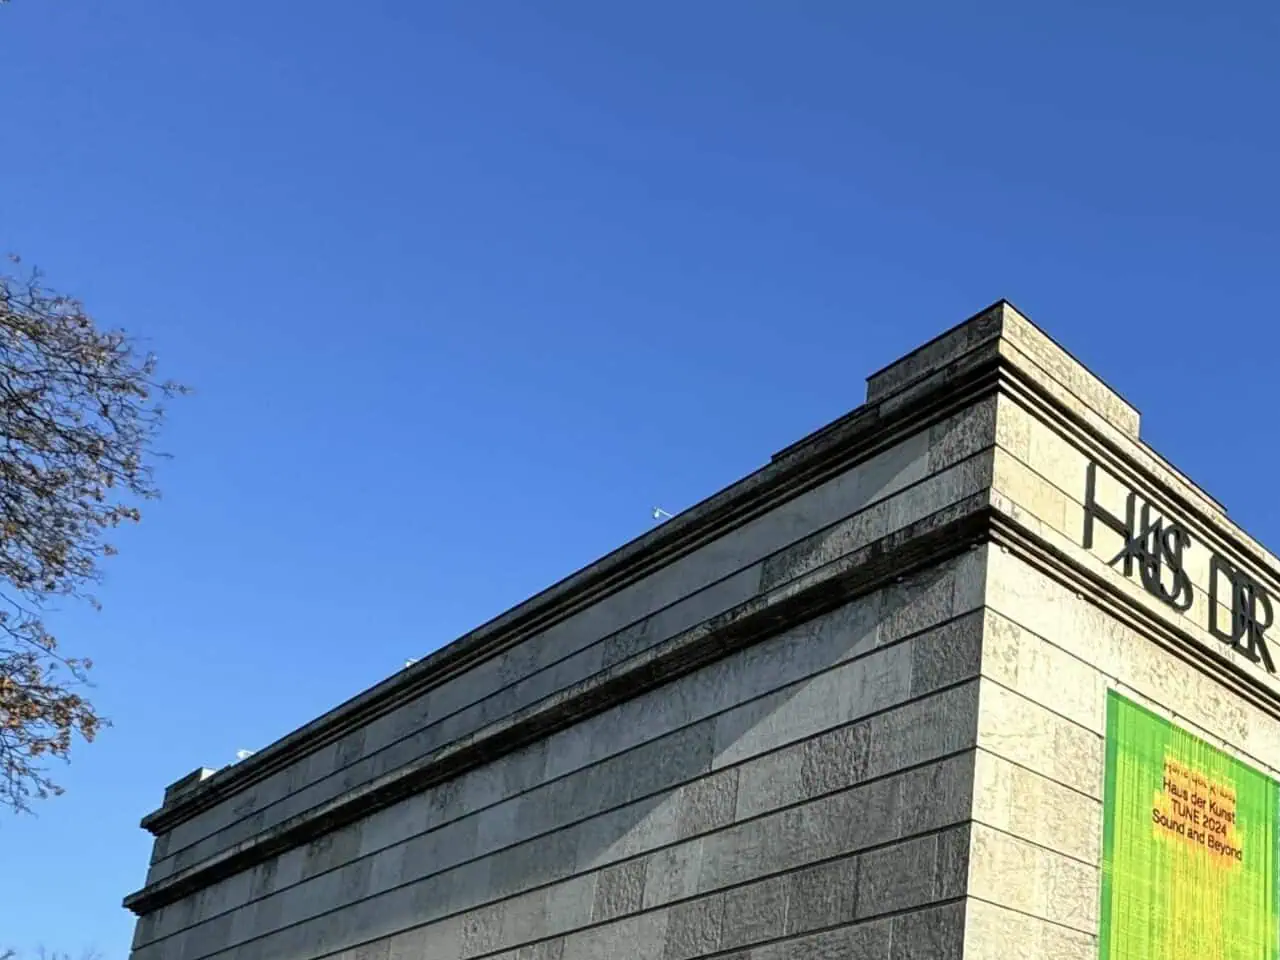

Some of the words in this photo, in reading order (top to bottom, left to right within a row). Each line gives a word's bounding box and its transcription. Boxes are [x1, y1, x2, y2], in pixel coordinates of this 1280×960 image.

[1163, 776, 1189, 802] Haus
[1191, 792, 1207, 809] der
[1209, 798, 1236, 825] Kunst
[1171, 799, 1200, 825] TUNE
[1203, 813, 1227, 838] 2024
[1152, 808, 1185, 836] Sound
[1187, 825, 1205, 844] and
[1207, 834, 1243, 862] Beyond
